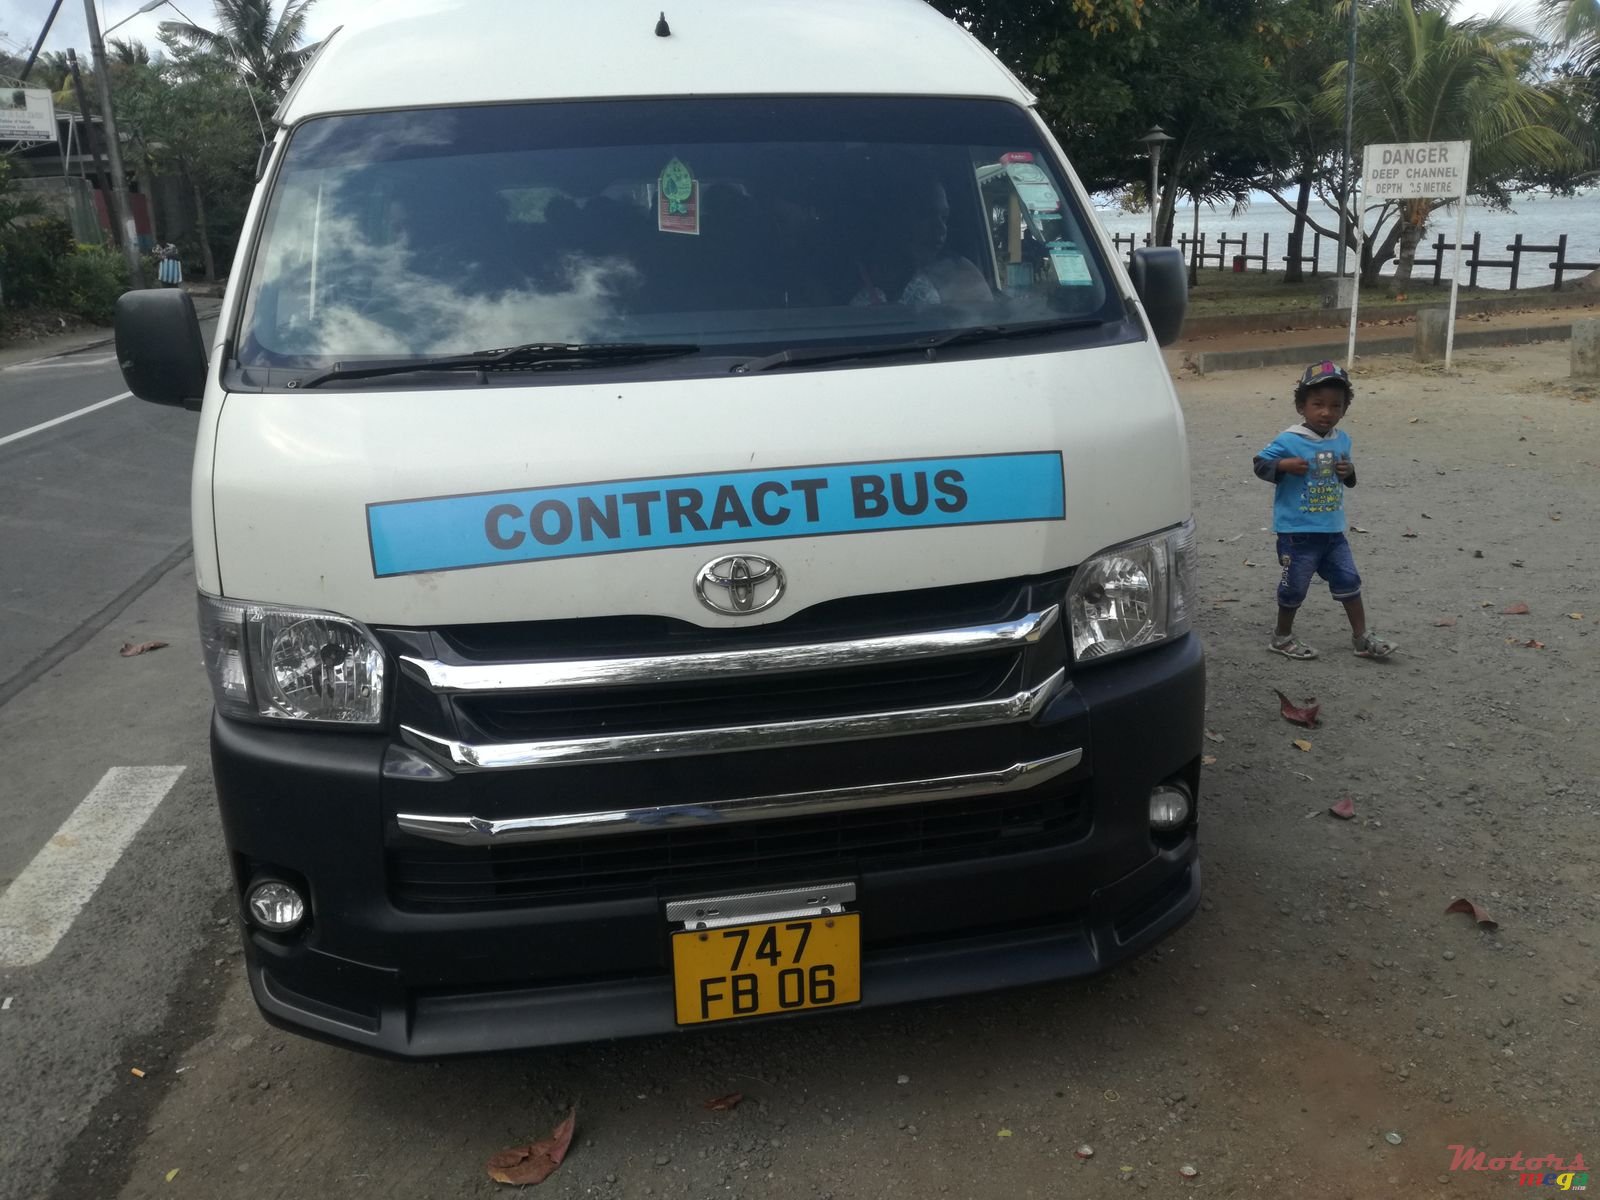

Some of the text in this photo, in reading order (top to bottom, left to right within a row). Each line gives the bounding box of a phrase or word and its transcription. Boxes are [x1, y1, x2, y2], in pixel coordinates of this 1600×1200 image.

[1382, 148, 1449, 164] DANGER
[1372, 167, 1458, 179] DEEP CHANNEL
[1376, 183, 1403, 193] DEPTH
[1423, 182, 1452, 192] METRE
[484, 469, 968, 550] CONTRACT BUS
[723, 922, 812, 971] 747
[700, 964, 835, 1019] FB 06
